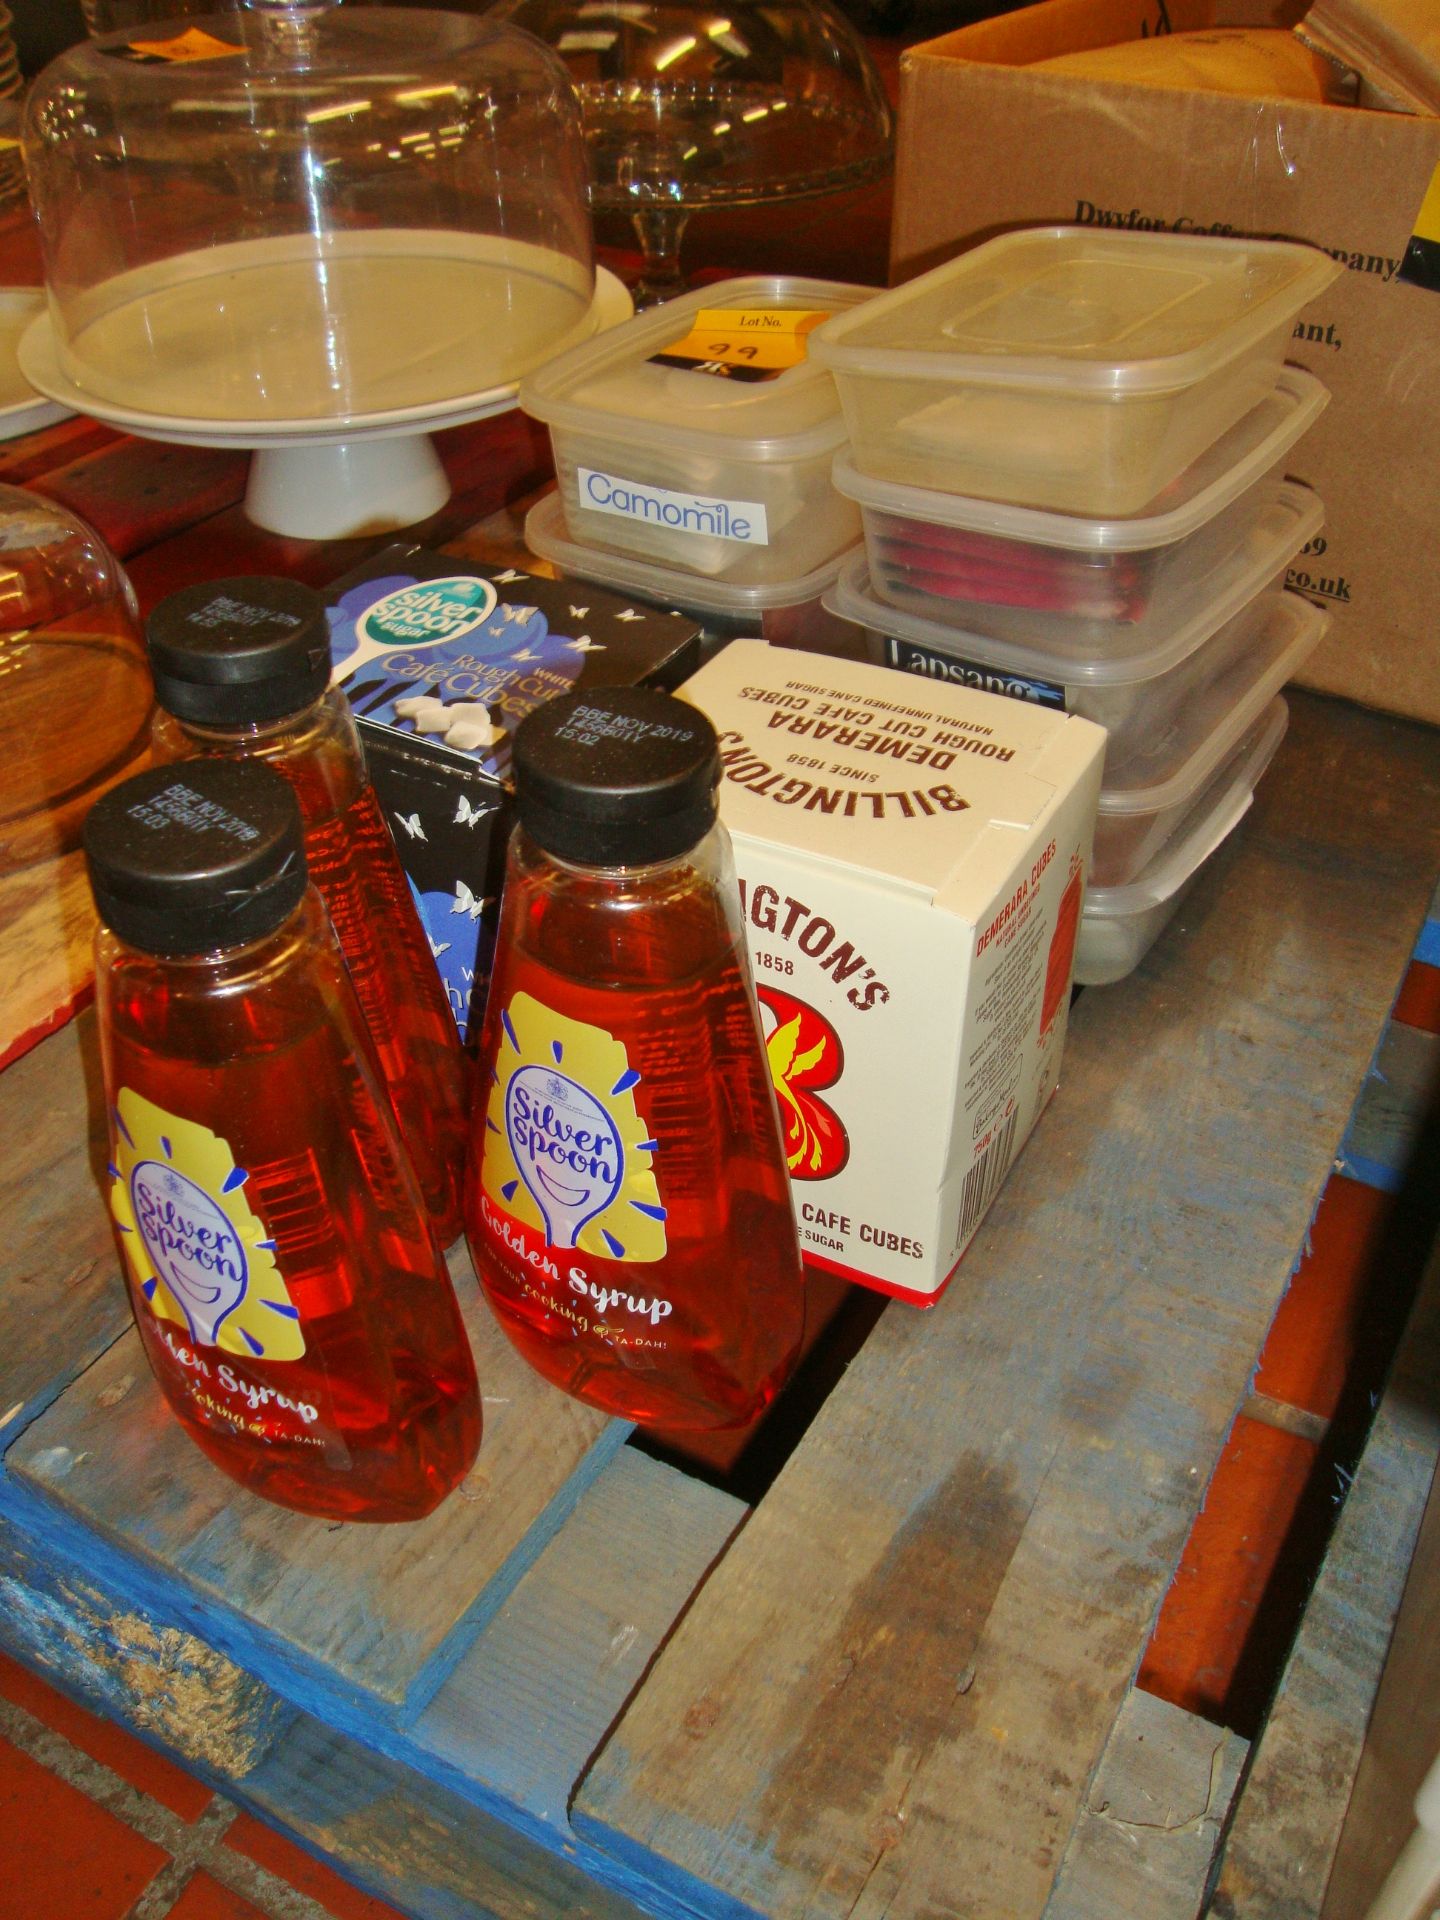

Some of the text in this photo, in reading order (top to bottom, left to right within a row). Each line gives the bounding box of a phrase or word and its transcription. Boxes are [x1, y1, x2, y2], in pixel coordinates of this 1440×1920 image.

[740, 316, 782, 327] Lot No.
[1291, 322, 1342, 352] ant,
[587, 473, 751, 539] Camomile
[1284, 569, 1351, 602] co.uk
[382, 654, 541, 720] Café Cubes
[452, 654, 521, 687] Rough
[611, 715, 653, 732] NOV
[650, 724, 695, 742] 2019
[738, 686, 1017, 762] ROUGH CUT CAFE CUBES
[785, 680, 994, 736] NATURAL UNREFINED CANE SUGAR
[767, 710, 958, 771] DEMERARA
[786, 753, 880, 783] SINCE 1858
[976, 879, 1029, 958] DEMERARA
[1031, 838, 1057, 886] CUBES
[755, 951, 794, 976] 1858
[514, 1086, 613, 1156] Silver
[137, 1182, 233, 1255] Silver
[802, 1203, 925, 1260] CAFE CUBES
[804, 1229, 845, 1253] SUGAR
[481, 1195, 673, 1326] Golden Syrup
[217, 1364, 319, 1425] Syrup
